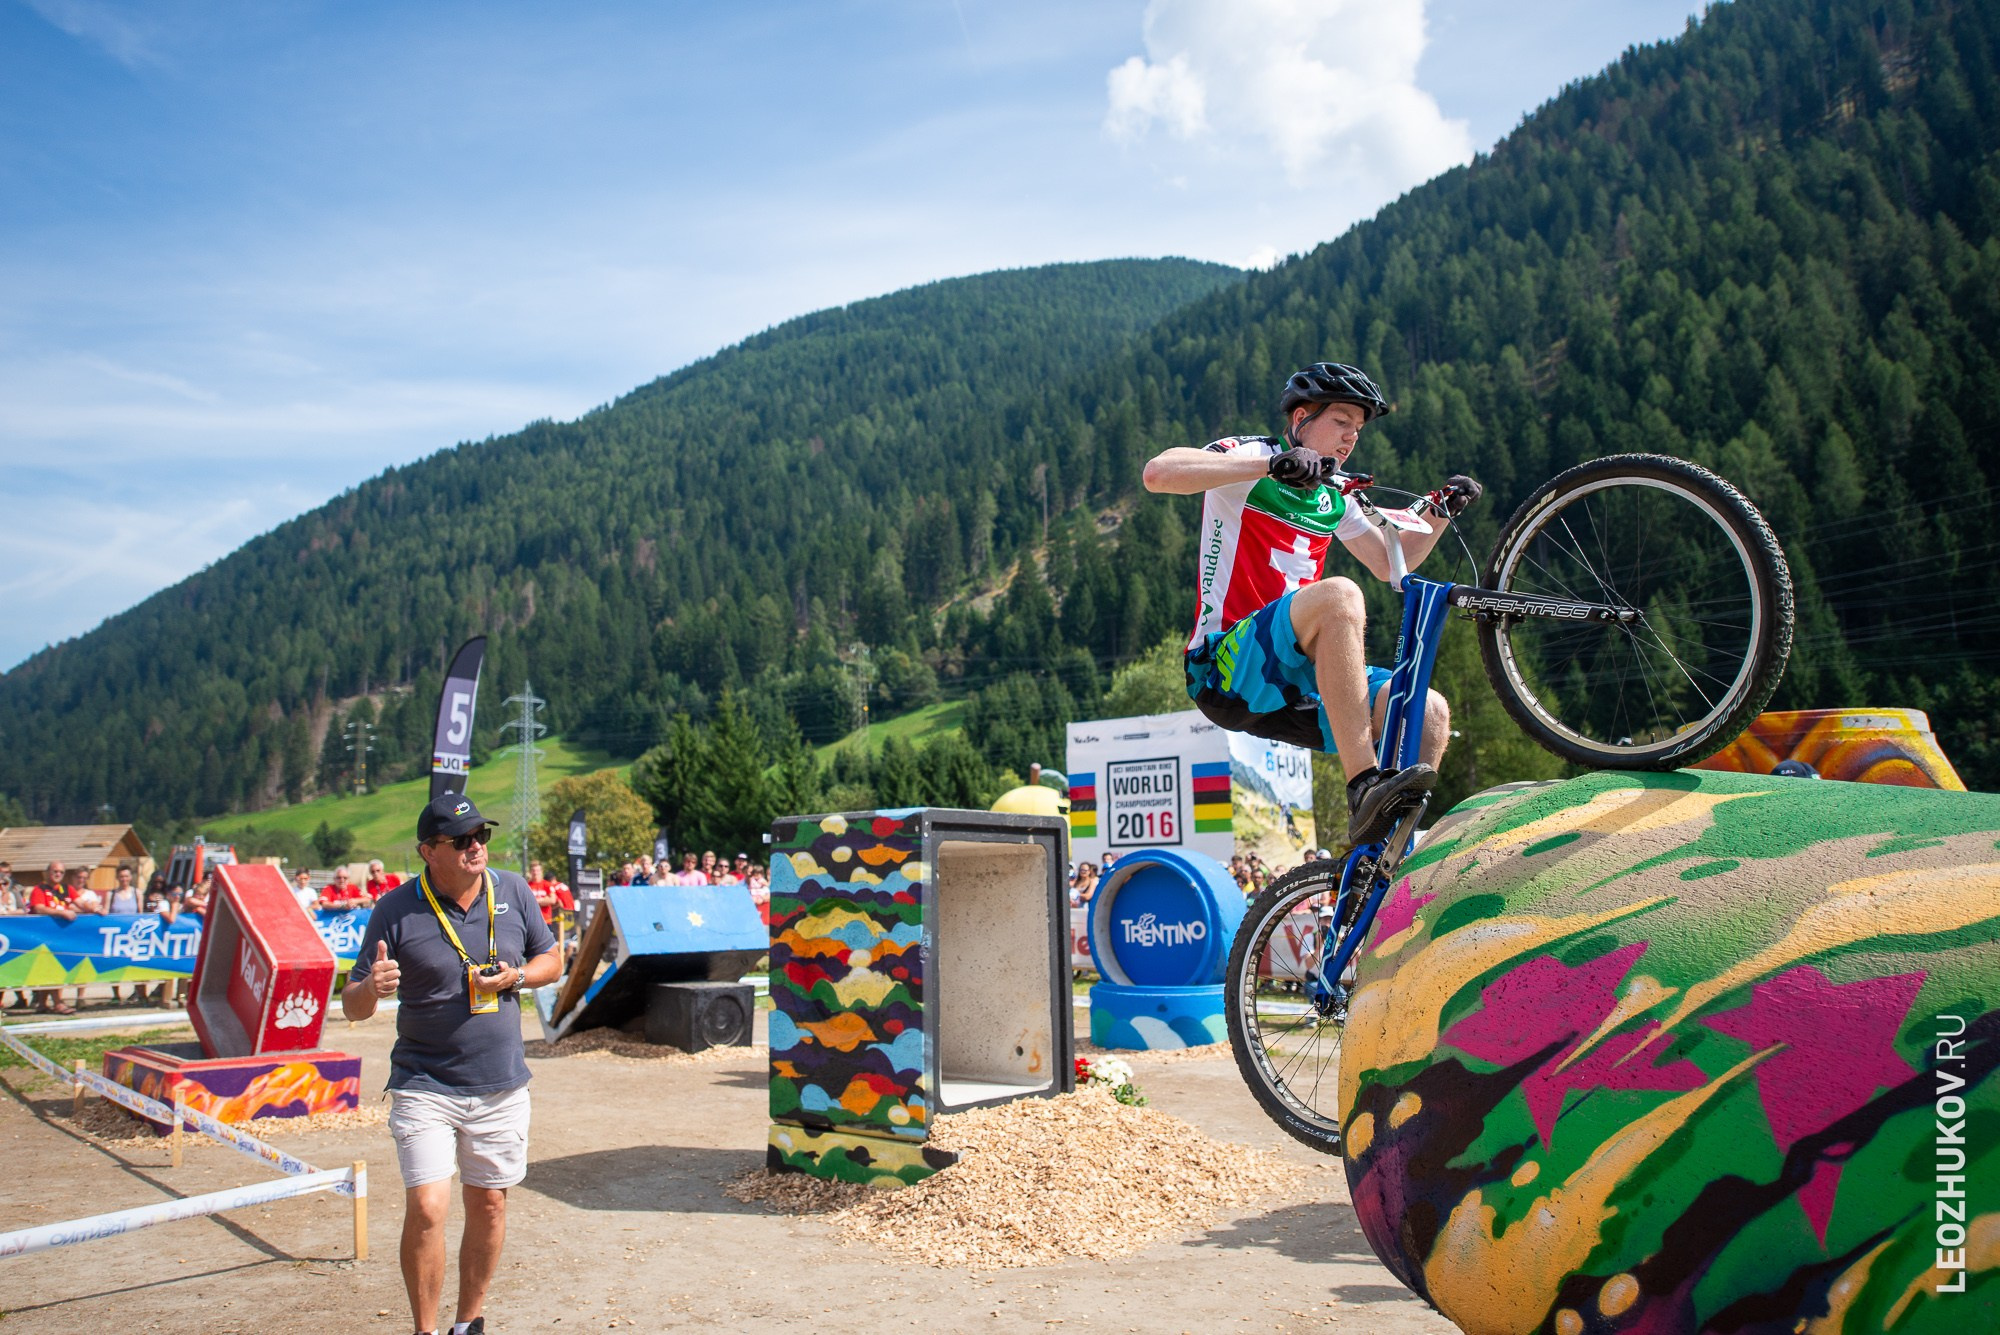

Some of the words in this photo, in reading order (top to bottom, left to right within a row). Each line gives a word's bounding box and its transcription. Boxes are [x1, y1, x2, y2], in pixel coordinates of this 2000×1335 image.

[1202, 519, 1224, 596] vaudoise
[1456, 594, 1592, 619] #HASHTAGG
[446, 692, 471, 745] 5
[1277, 755, 1308, 780] FUN
[1113, 774, 1173, 796] WORLD
[571, 825, 584, 845] 4
[1117, 811, 1174, 839] 2016
[656, 842, 666, 859] 3
[1120, 919, 1206, 947] TRENTINO
